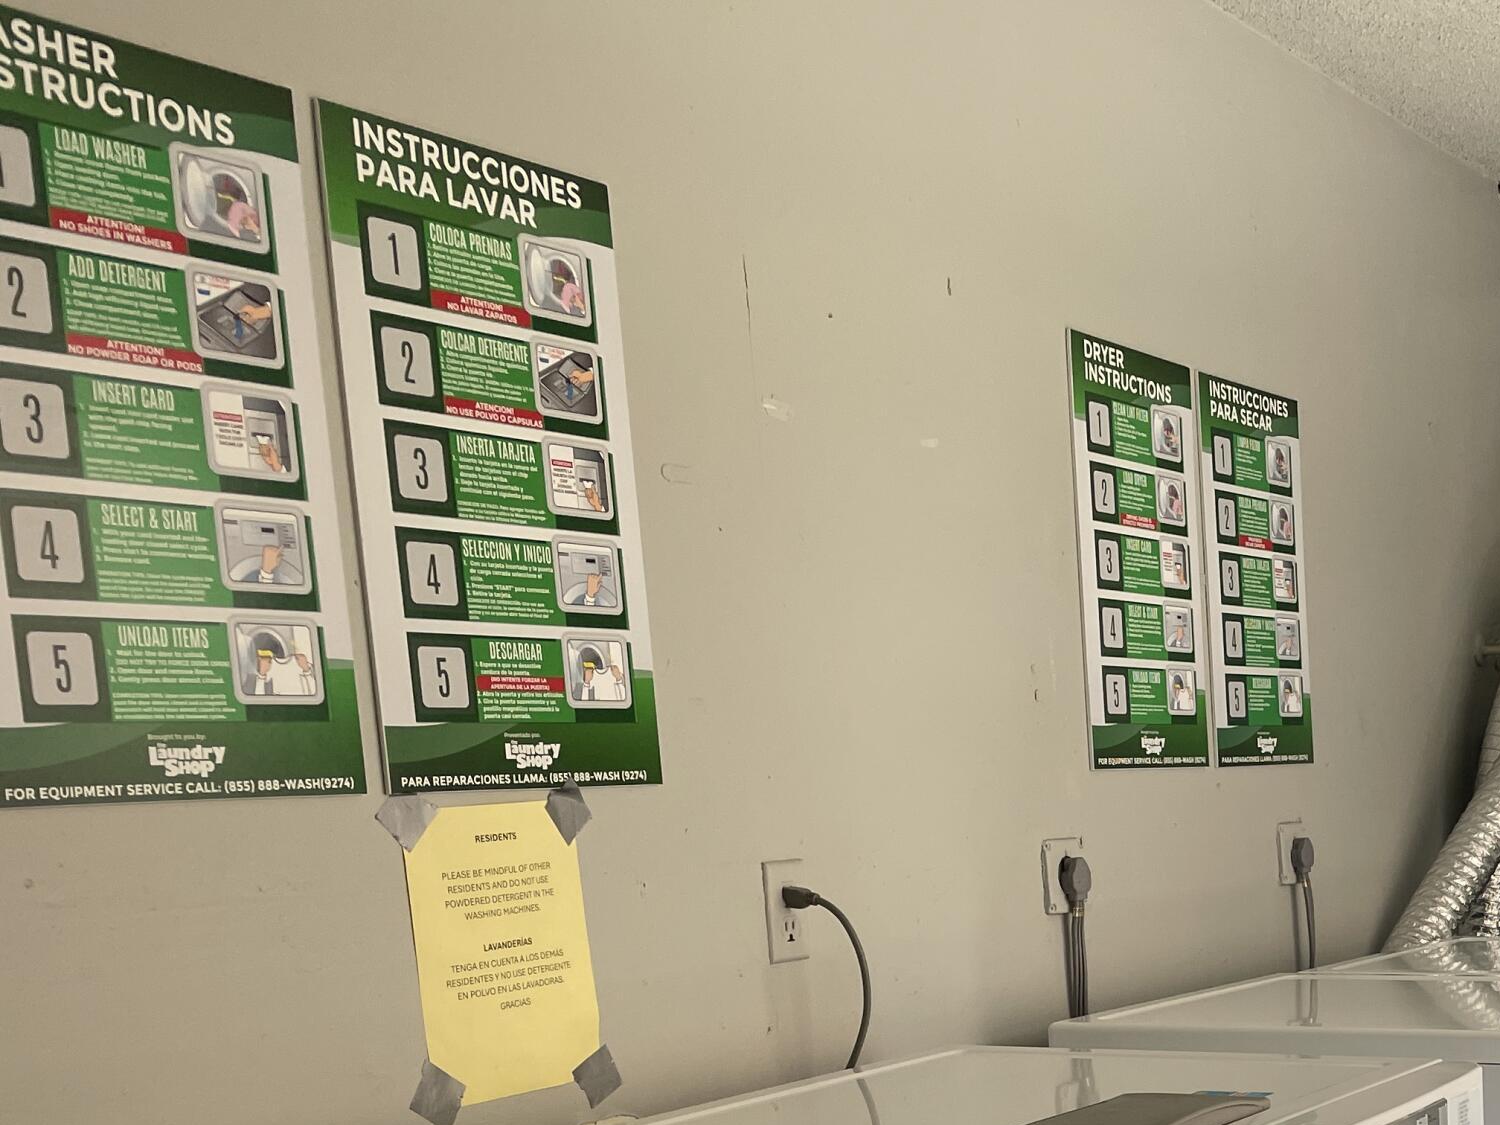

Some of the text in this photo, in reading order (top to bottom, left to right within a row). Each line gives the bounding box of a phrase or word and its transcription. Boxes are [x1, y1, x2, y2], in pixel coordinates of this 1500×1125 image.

[54, 126, 147, 169] LOAD WASHER
[352, 117, 582, 209] INSTRUCCIONES
[356, 152, 537, 229] PARA LAVAR
[469, 232, 512, 261] PRENDAS
[68, 254, 167, 293] ADD DETERGENT
[7, 266, 27, 318] 2
[68, 344, 202, 372] NO POWDER SOAP OR PODS
[478, 337, 529, 364] DETERGENTE
[1083, 338, 1125, 369] DRYER
[92, 380, 175, 411] INSERT CARD
[1084, 361, 1172, 404] INSTRUCTIONS
[1209, 380, 1289, 418] INSTRUCCIONES
[22, 394, 44, 444] 3
[446, 406, 458, 415] NO
[459, 408, 473, 417] USE
[475, 410, 499, 421] POLVO
[507, 416, 543, 428] CAPSULAS
[1210, 400, 1272, 433] PARA SECAR
[456, 434, 536, 464] INSERTA TARJETA
[1101, 478, 1108, 506] 2
[100, 503, 198, 532] SELECT & START
[40, 520, 59, 570] 4
[462, 538, 552, 564] SELECCION Y INICIO
[1105, 547, 1113, 574] 3
[117, 625, 209, 648] UNLOAD ITEMS
[1109, 613, 1116, 641] 4
[489, 641, 543, 661] DESCARGAR
[51, 645, 72, 693] 5
[1113, 681, 1120, 708] 5
[5, 788, 36, 801] FOR
[40, 785, 123, 800] EQUIPMENT
[127, 783, 182, 797] SERVICE
[186, 781, 222, 794] CALL:
[224, 779, 255, 794] (855)
[401, 776, 430, 788] PARA
[433, 774, 511, 787] REPARACIONES
[513, 773, 548, 784] LLAMA:
[573, 771, 620, 782] 888-WASH
[621, 770, 647, 782] (9274)
[475, 832, 517, 843] RESIDENTS
[441, 861, 551, 881] PLEASE BE MINDFUL OF OTHER
[447, 875, 549, 894] RESIDENTS AND DO NOT USE
[500, 997, 532, 1010] GRACIAS
